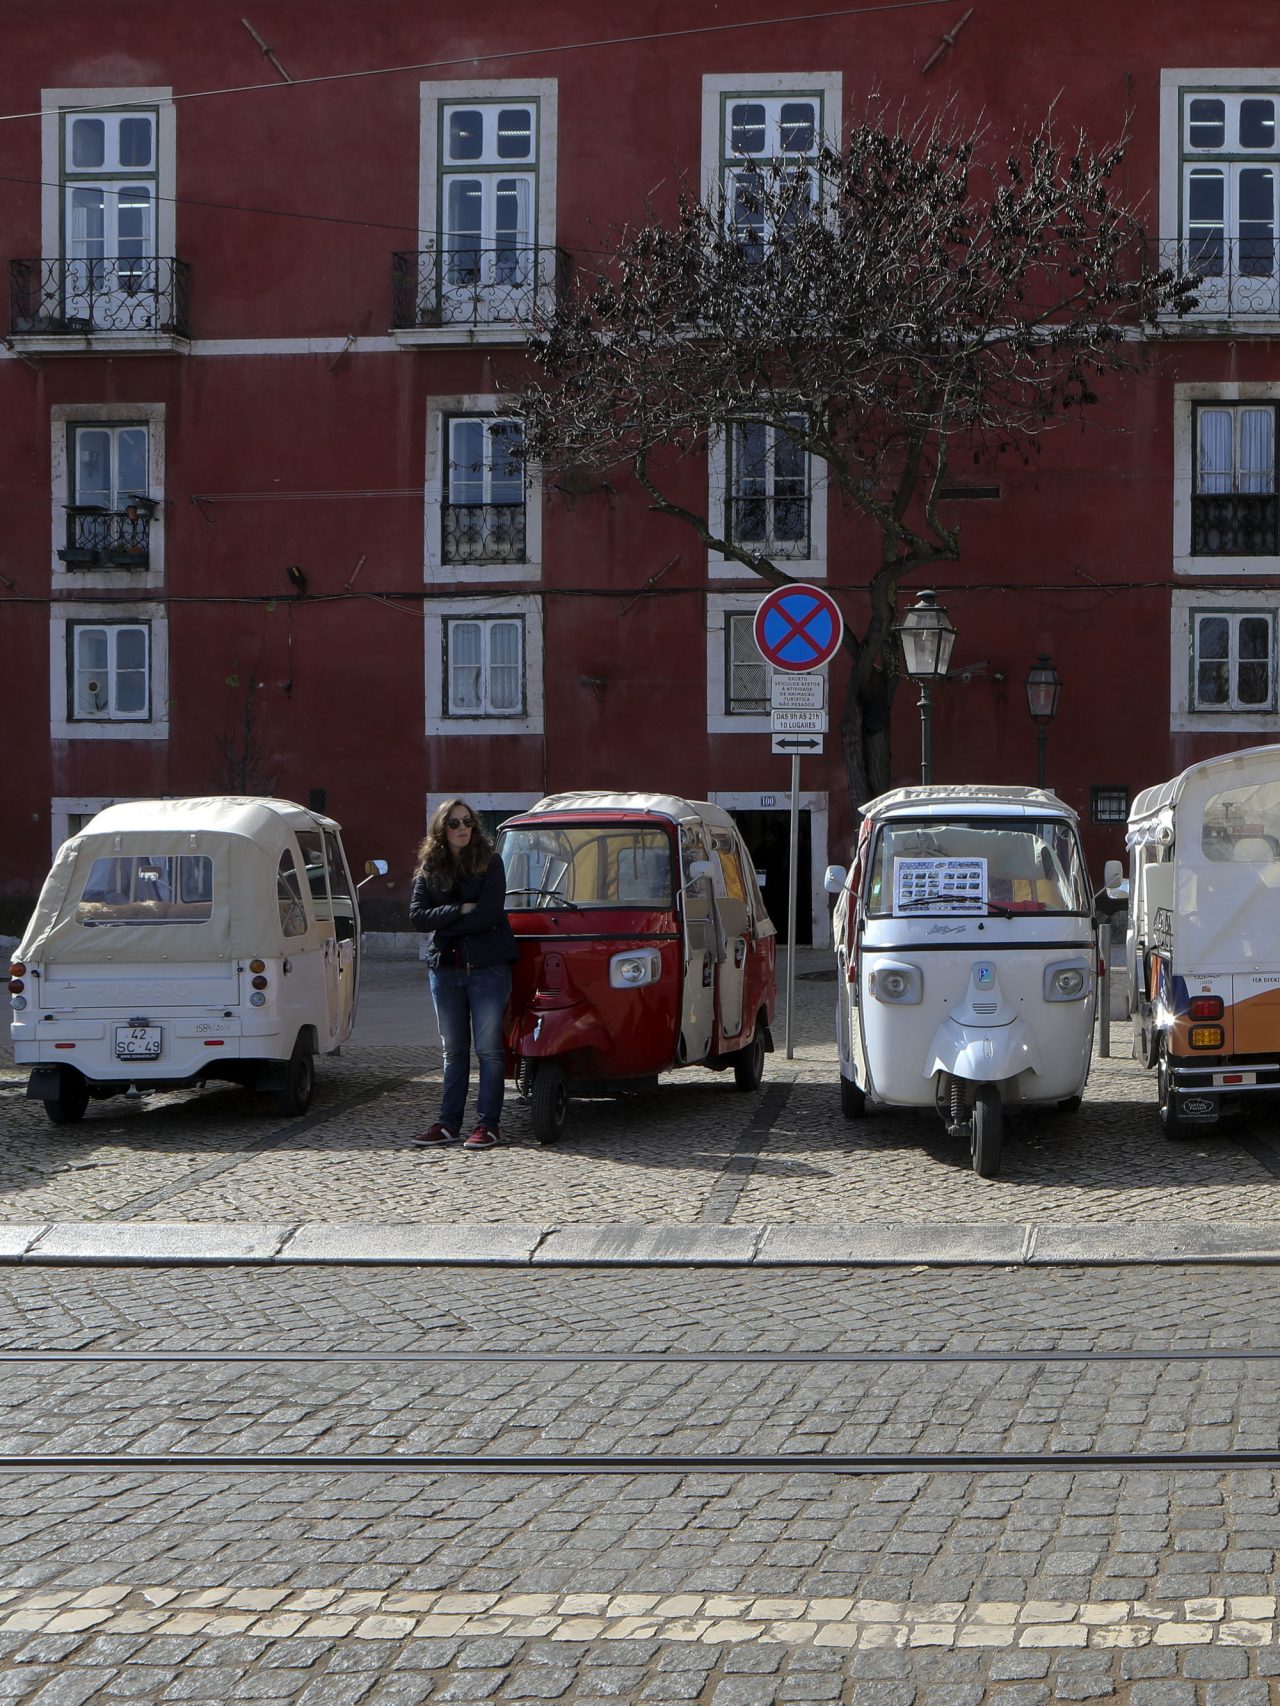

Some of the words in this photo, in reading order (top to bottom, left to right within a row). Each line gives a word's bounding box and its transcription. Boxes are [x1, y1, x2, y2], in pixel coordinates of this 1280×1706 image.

[762, 796, 774, 806] 100
[131, 1029, 146, 1040] 42
[117, 1042, 136, 1052] SC
[145, 1041, 160, 1052] 49
